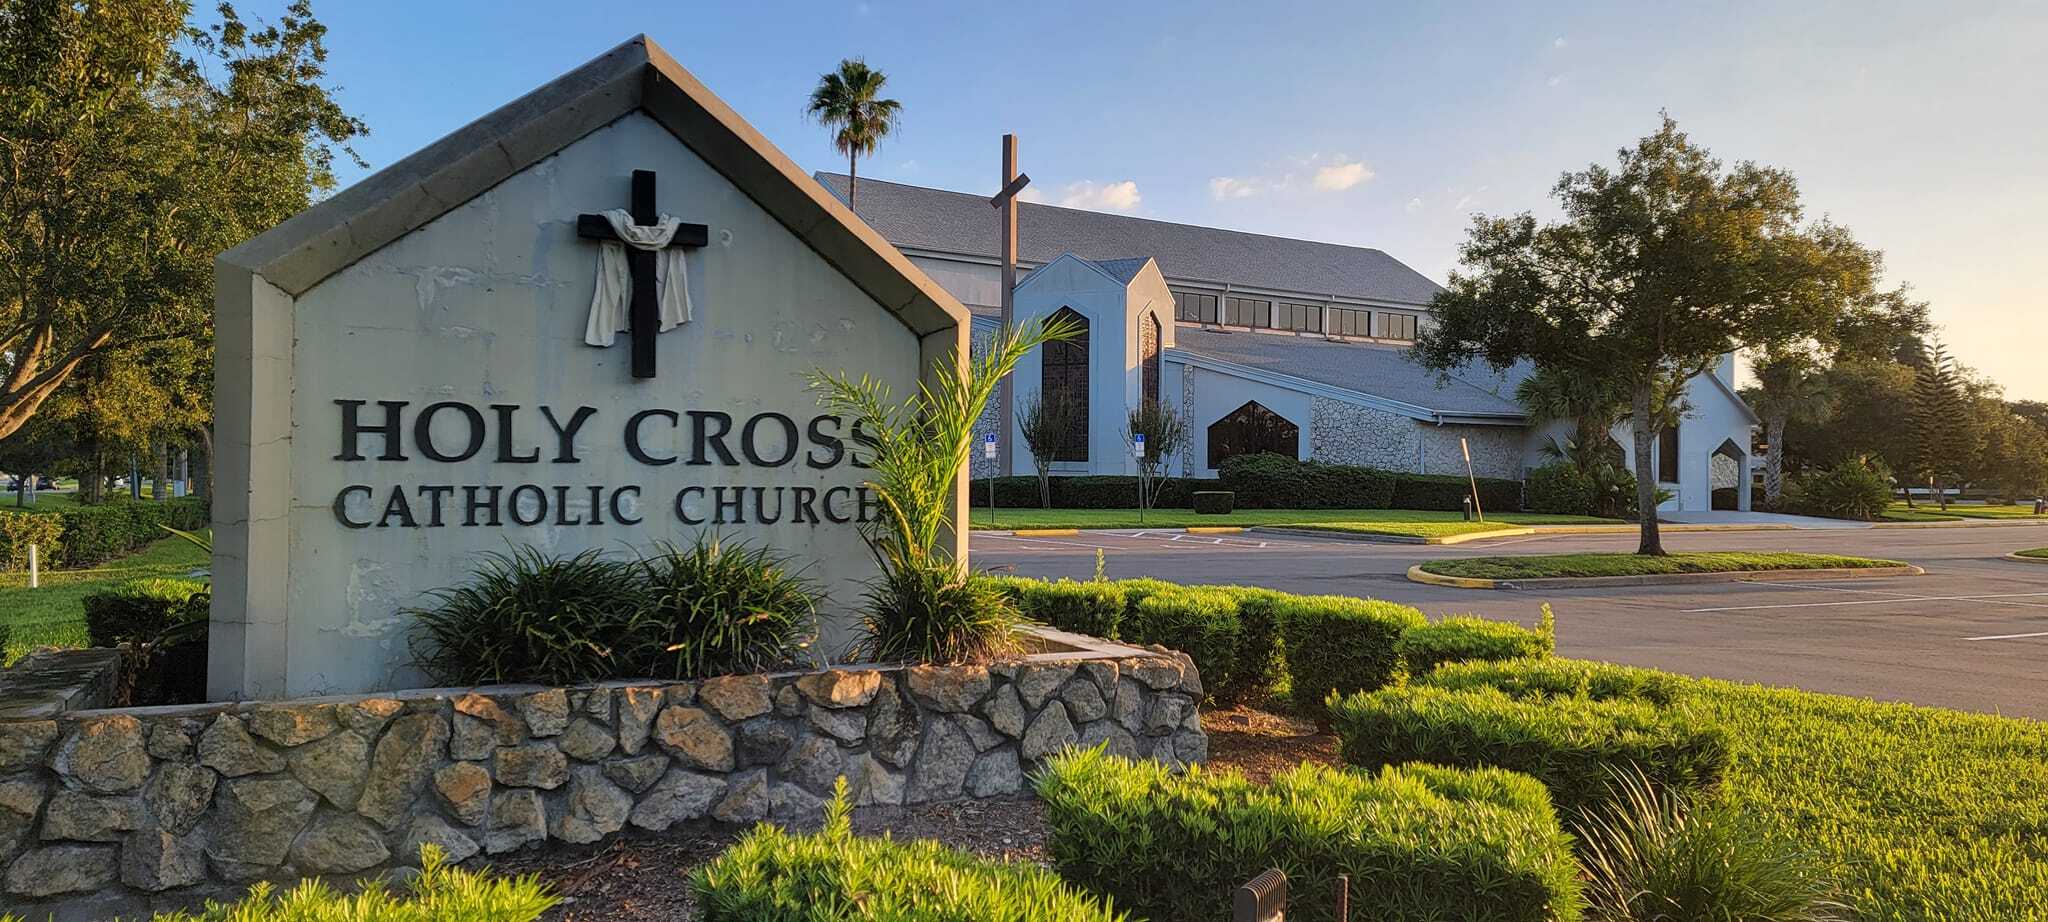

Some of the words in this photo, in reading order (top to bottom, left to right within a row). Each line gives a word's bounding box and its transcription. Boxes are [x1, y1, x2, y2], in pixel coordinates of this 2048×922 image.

[333, 400, 597, 463] HOLY
[624, 409, 885, 470] CROSS
[333, 484, 643, 529] CATHOLIC
